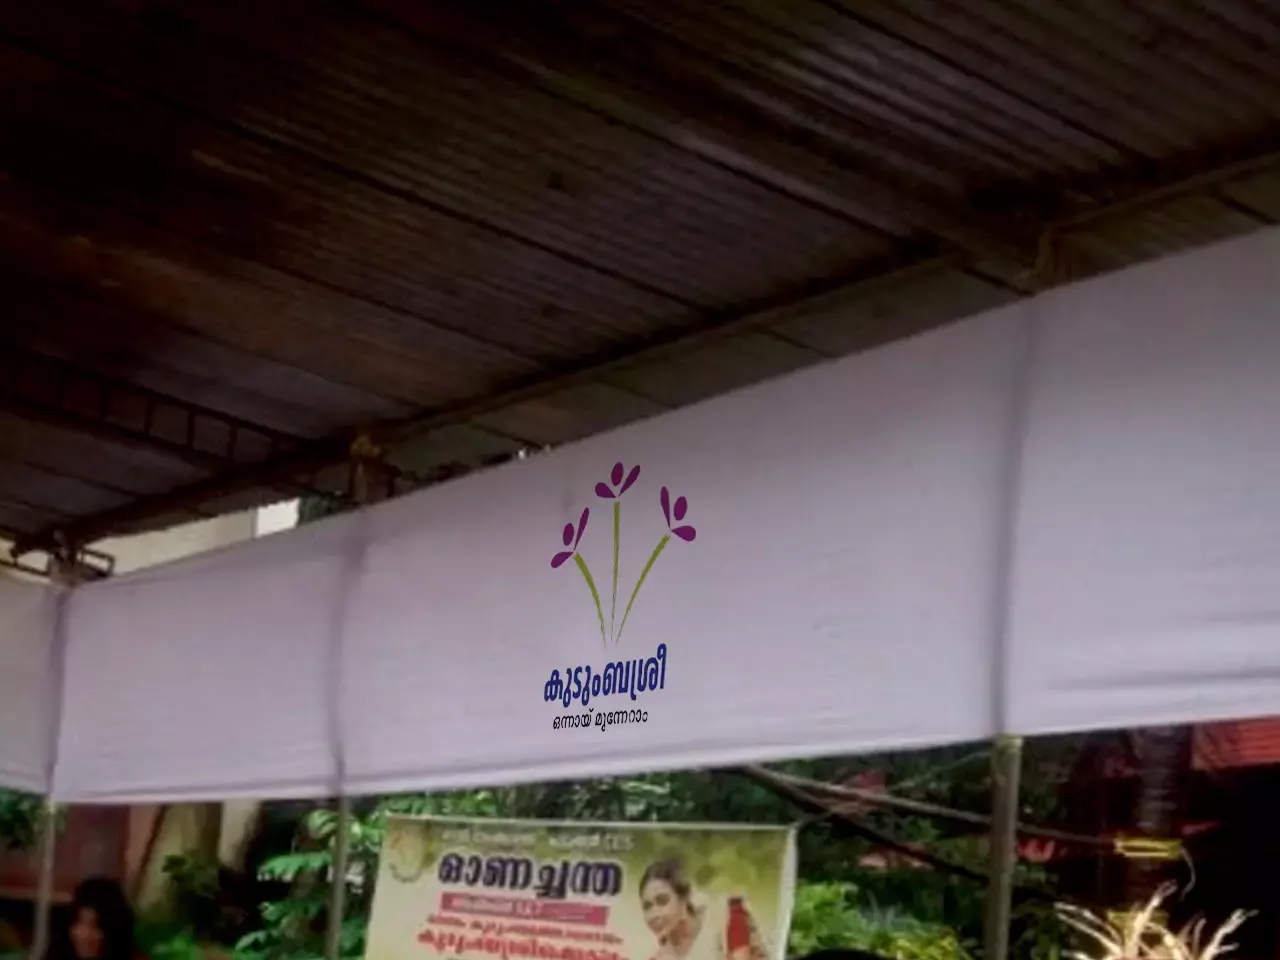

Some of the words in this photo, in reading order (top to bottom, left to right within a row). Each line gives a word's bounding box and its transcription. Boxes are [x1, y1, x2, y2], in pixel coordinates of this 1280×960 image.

[543, 643, 667, 708] കുടുംബശ്രീ
[552, 708, 594, 730] ഒന്നായ്
[594, 709, 649, 732] മുന്നേറാം
[438, 852, 623, 899] ഓണച്ചന്ത
